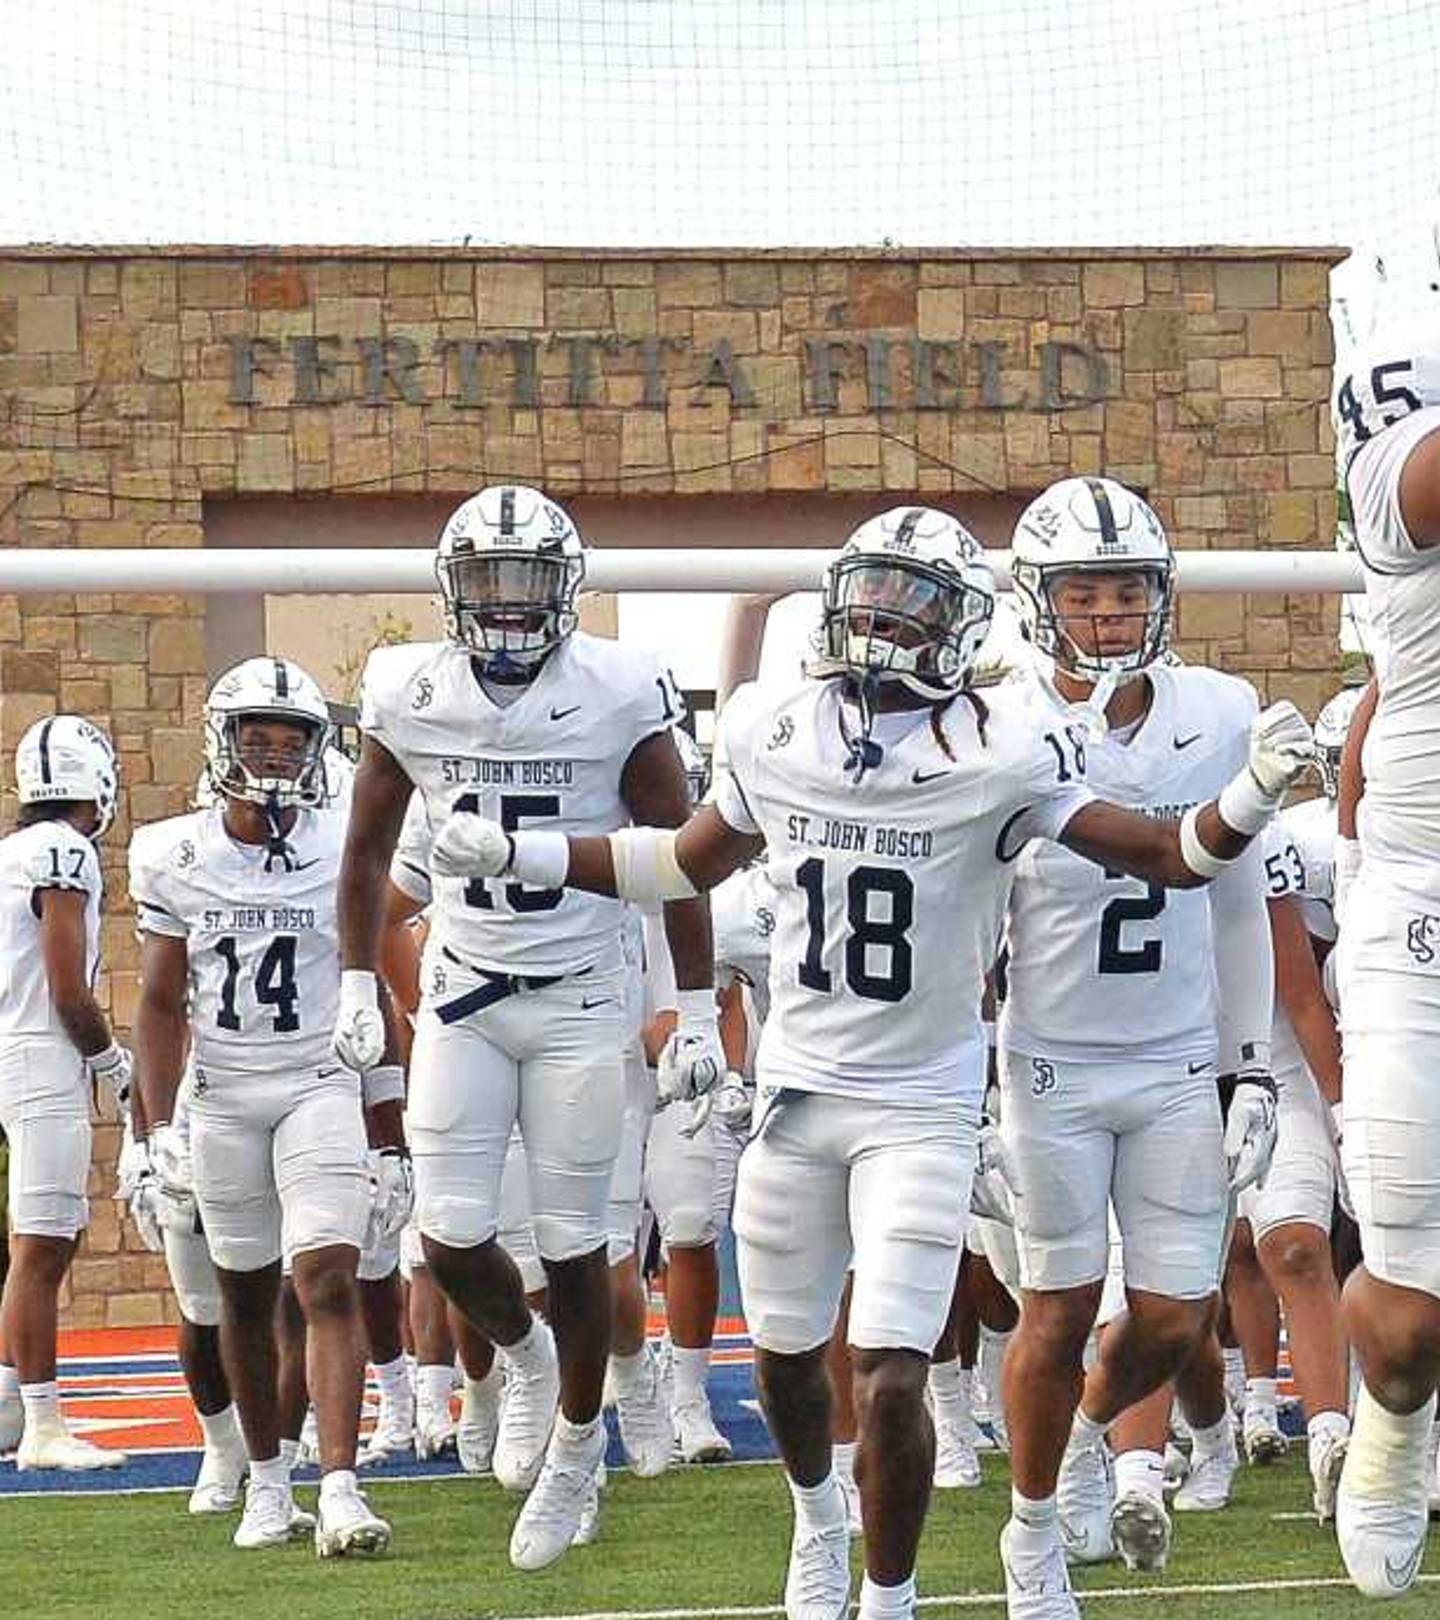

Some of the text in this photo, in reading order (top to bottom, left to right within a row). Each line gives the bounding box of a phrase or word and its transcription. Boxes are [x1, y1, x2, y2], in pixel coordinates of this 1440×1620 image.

[226, 334, 1112, 411] FERTITTA FIELD
[1337, 360, 1423, 443] 45
[442, 760, 574, 785] ST. JOHN BOSCO
[49, 847, 86, 879] 17
[788, 815, 934, 857] ST. JOHN BOSCO
[1264, 844, 1307, 893] 53
[205, 908, 315, 930] ST. JOHN BOSCO
[795, 856, 917, 1003] 18
[1099, 864, 1168, 975] 2
[214, 935, 300, 1033] 14
